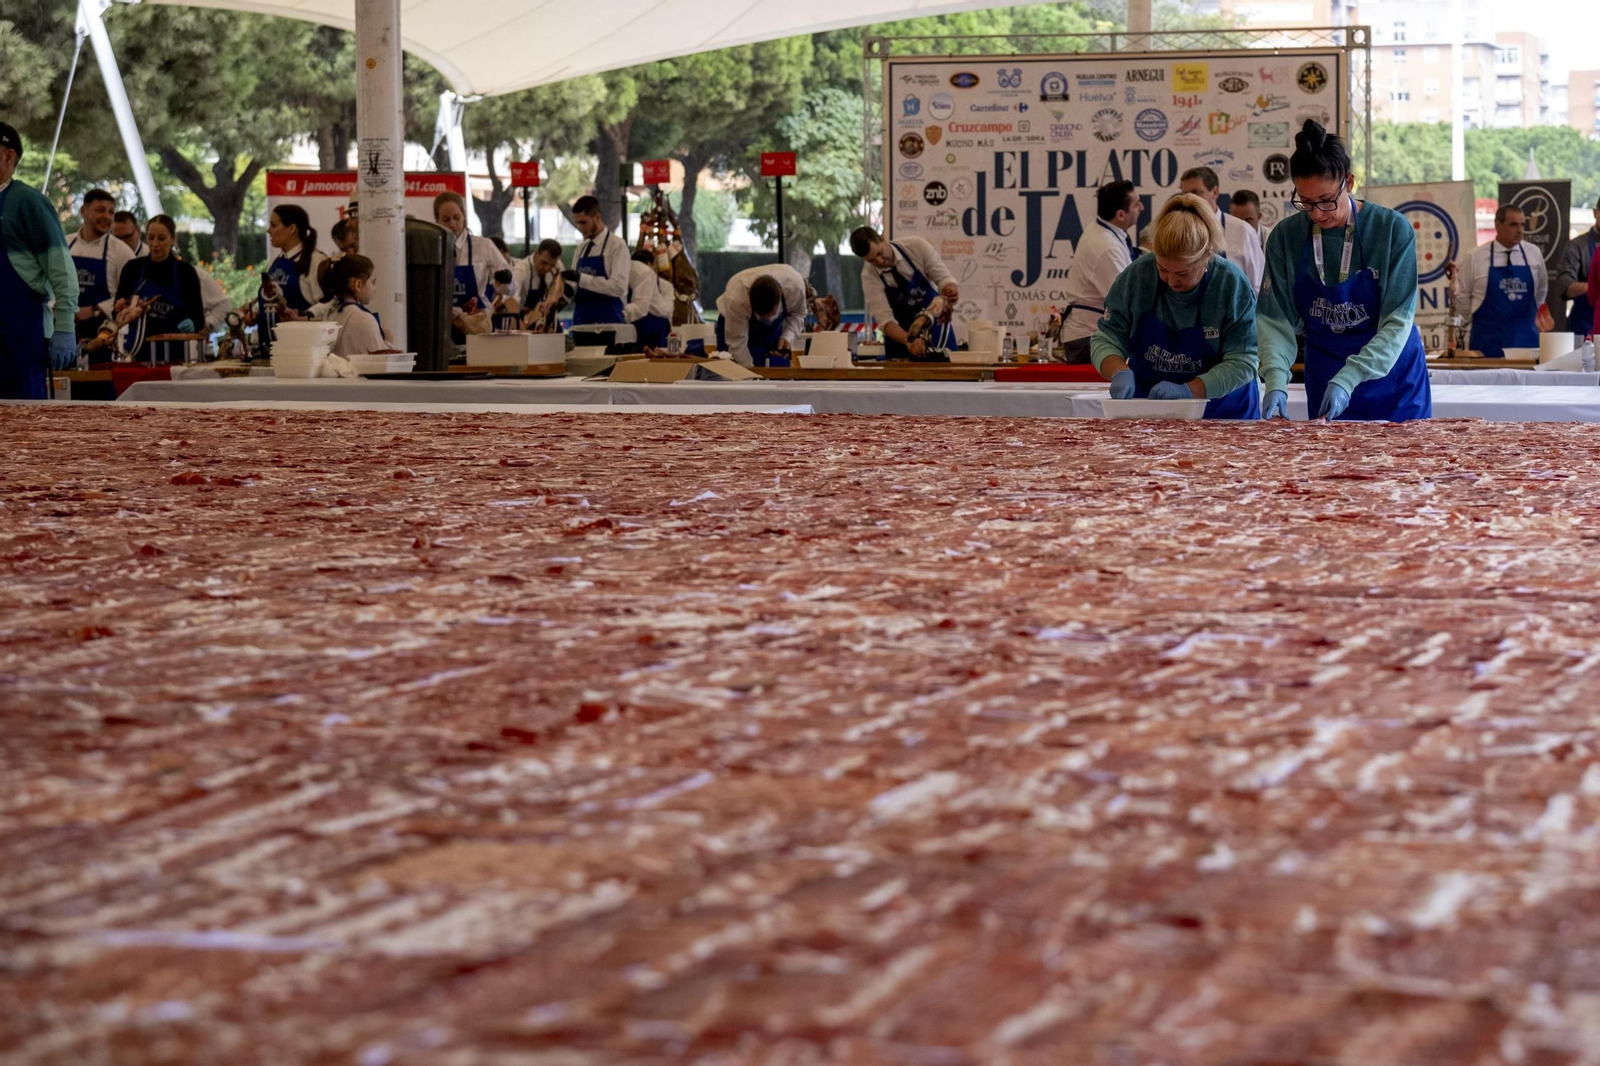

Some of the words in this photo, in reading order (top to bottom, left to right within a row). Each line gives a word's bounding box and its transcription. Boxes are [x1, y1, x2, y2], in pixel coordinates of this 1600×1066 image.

[1125, 69, 1165, 82] ARNEGUI
[970, 104, 1009, 112] Carrefour
[948, 122, 1013, 134] Cruzcampo
[1046, 148, 1178, 188] PLATO
[925, 186, 947, 199] znb
[962, 170, 1016, 237] de
[1004, 289, 1045, 301] TOMÁS
